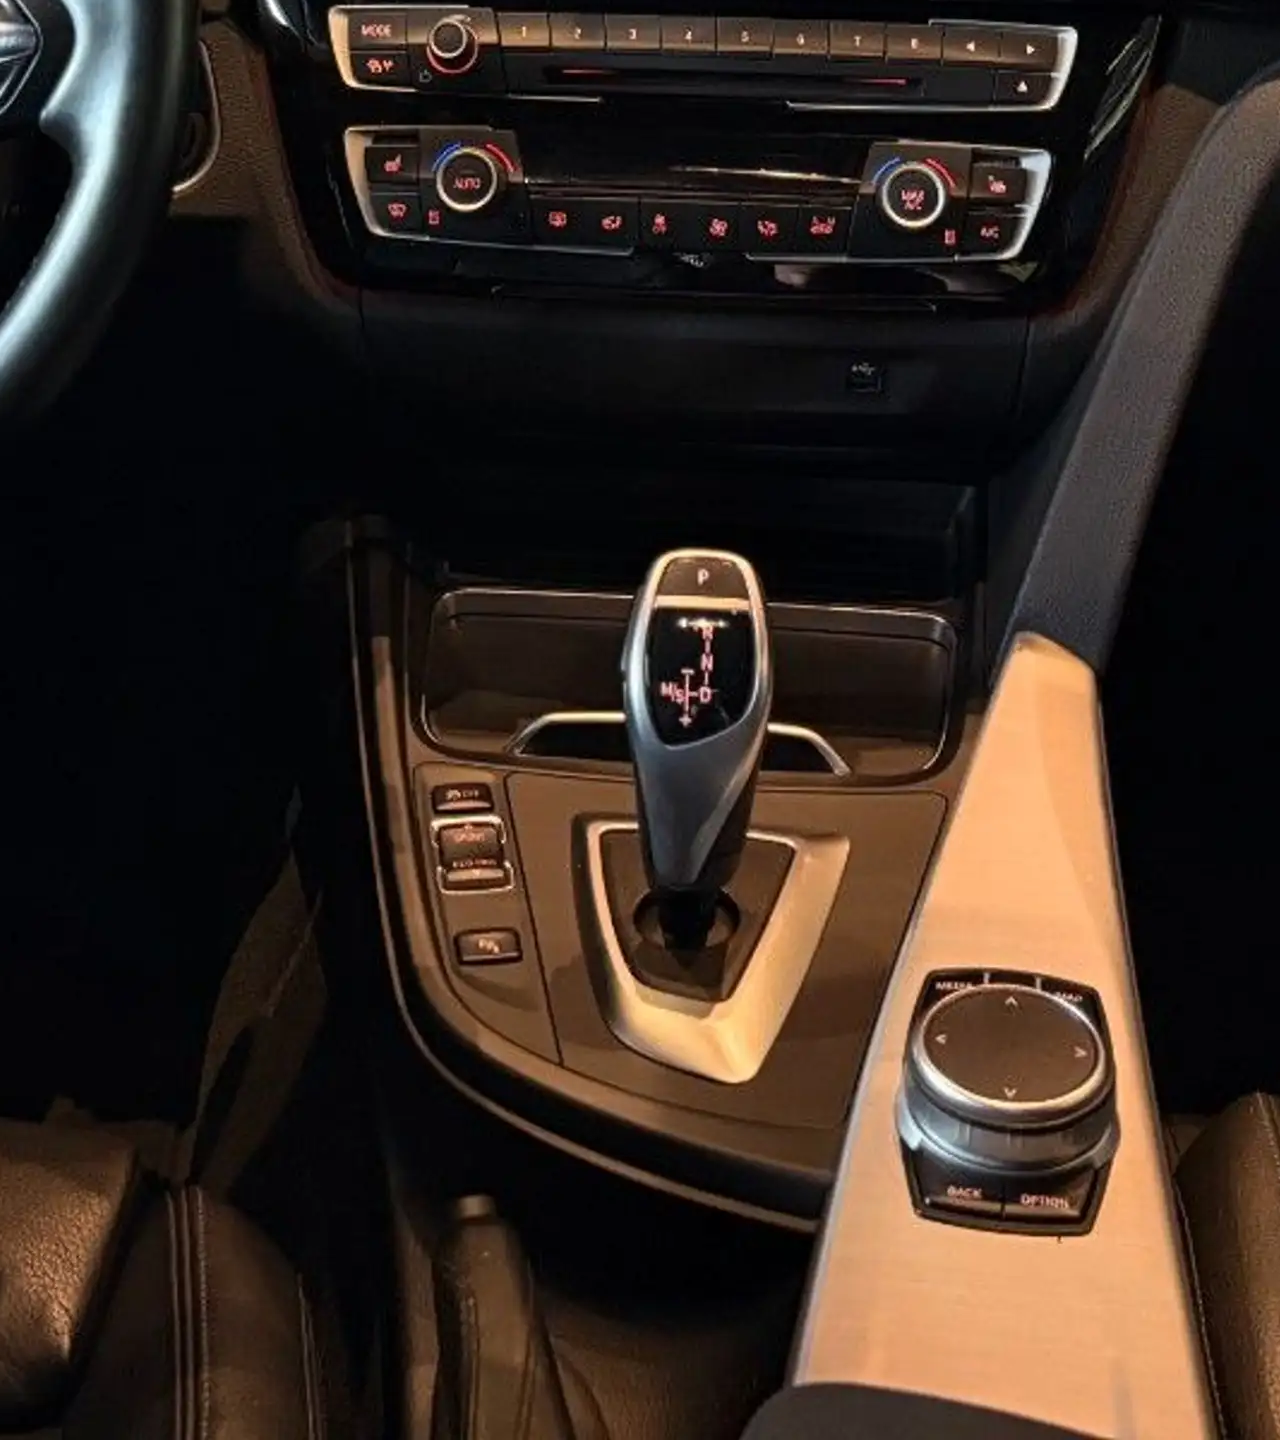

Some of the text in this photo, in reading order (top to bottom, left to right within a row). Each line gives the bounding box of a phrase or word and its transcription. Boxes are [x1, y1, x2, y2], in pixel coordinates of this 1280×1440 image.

[697, 568, 709, 585] P
[700, 653, 714, 672] N
[699, 686, 712, 703] D
[947, 1186, 982, 1198] BACK
[1020, 1193, 1069, 1209] OPTION
